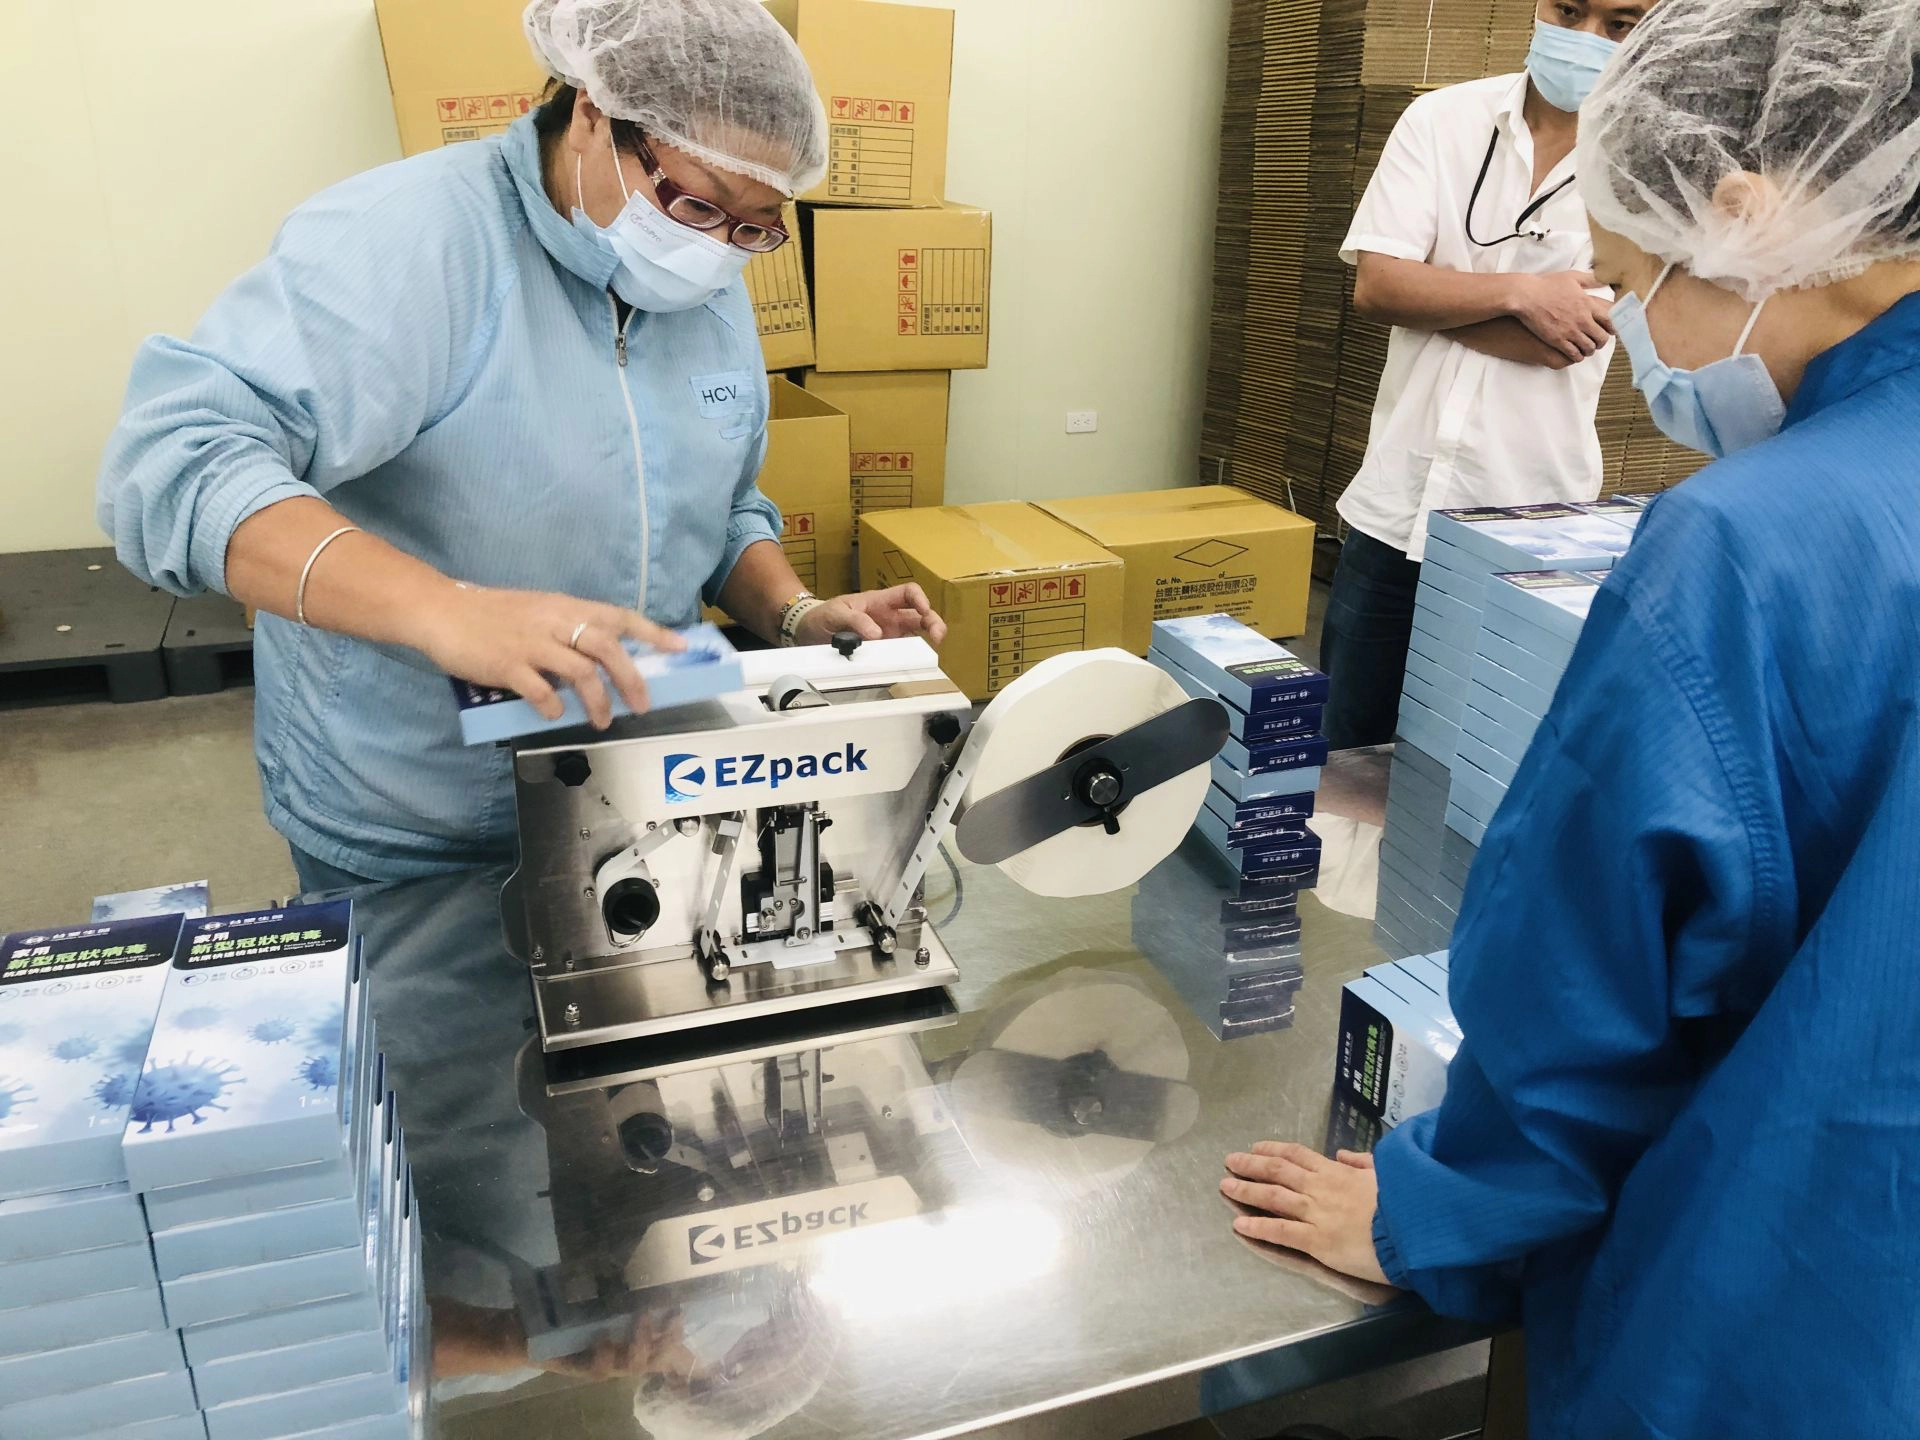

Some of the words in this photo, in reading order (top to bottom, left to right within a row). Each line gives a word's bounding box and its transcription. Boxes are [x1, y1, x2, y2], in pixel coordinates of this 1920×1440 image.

[702, 384, 736, 405] HCV
[715, 743, 868, 789] EZpack
[190, 930, 322, 955] 新型冠狀病毒
[6, 943, 147, 970] 新型冠狀病毒
